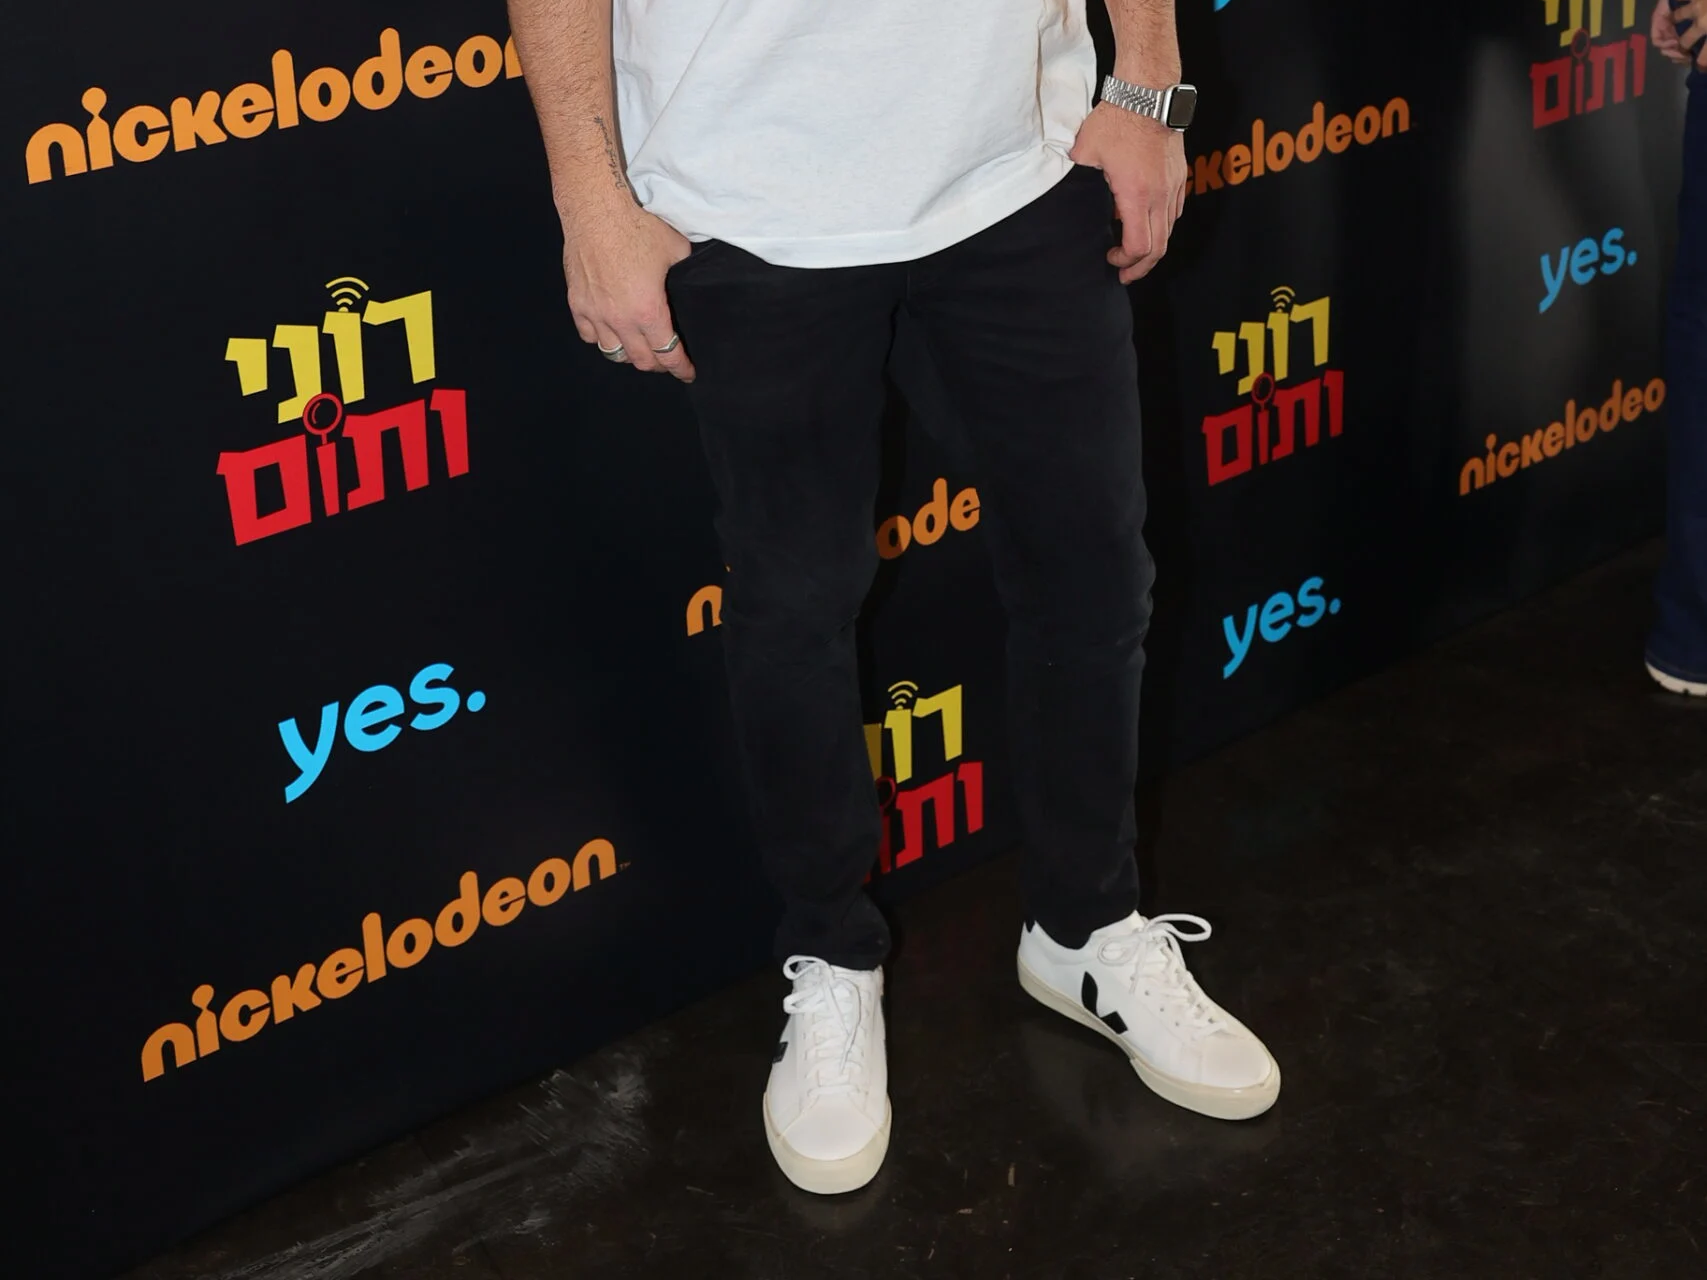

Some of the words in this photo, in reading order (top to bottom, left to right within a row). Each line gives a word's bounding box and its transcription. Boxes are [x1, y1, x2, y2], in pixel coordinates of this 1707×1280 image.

[25, 27, 525, 185] nickelodeo
[1529, 33, 1648, 130] ותום
[1185, 96, 1410, 197] kelodeon
[1539, 227, 1638, 314] yes.
[225, 290, 436, 424] רוני
[1211, 296, 1331, 396] רוני
[216, 388, 470, 547] ותום
[1203, 370, 1344, 486] ותום
[1459, 378, 1666, 496] nickelodeo
[1223, 577, 1341, 679] yes.
[278, 662, 487, 804] yes.
[141, 838, 617, 1083] nickelodeon
